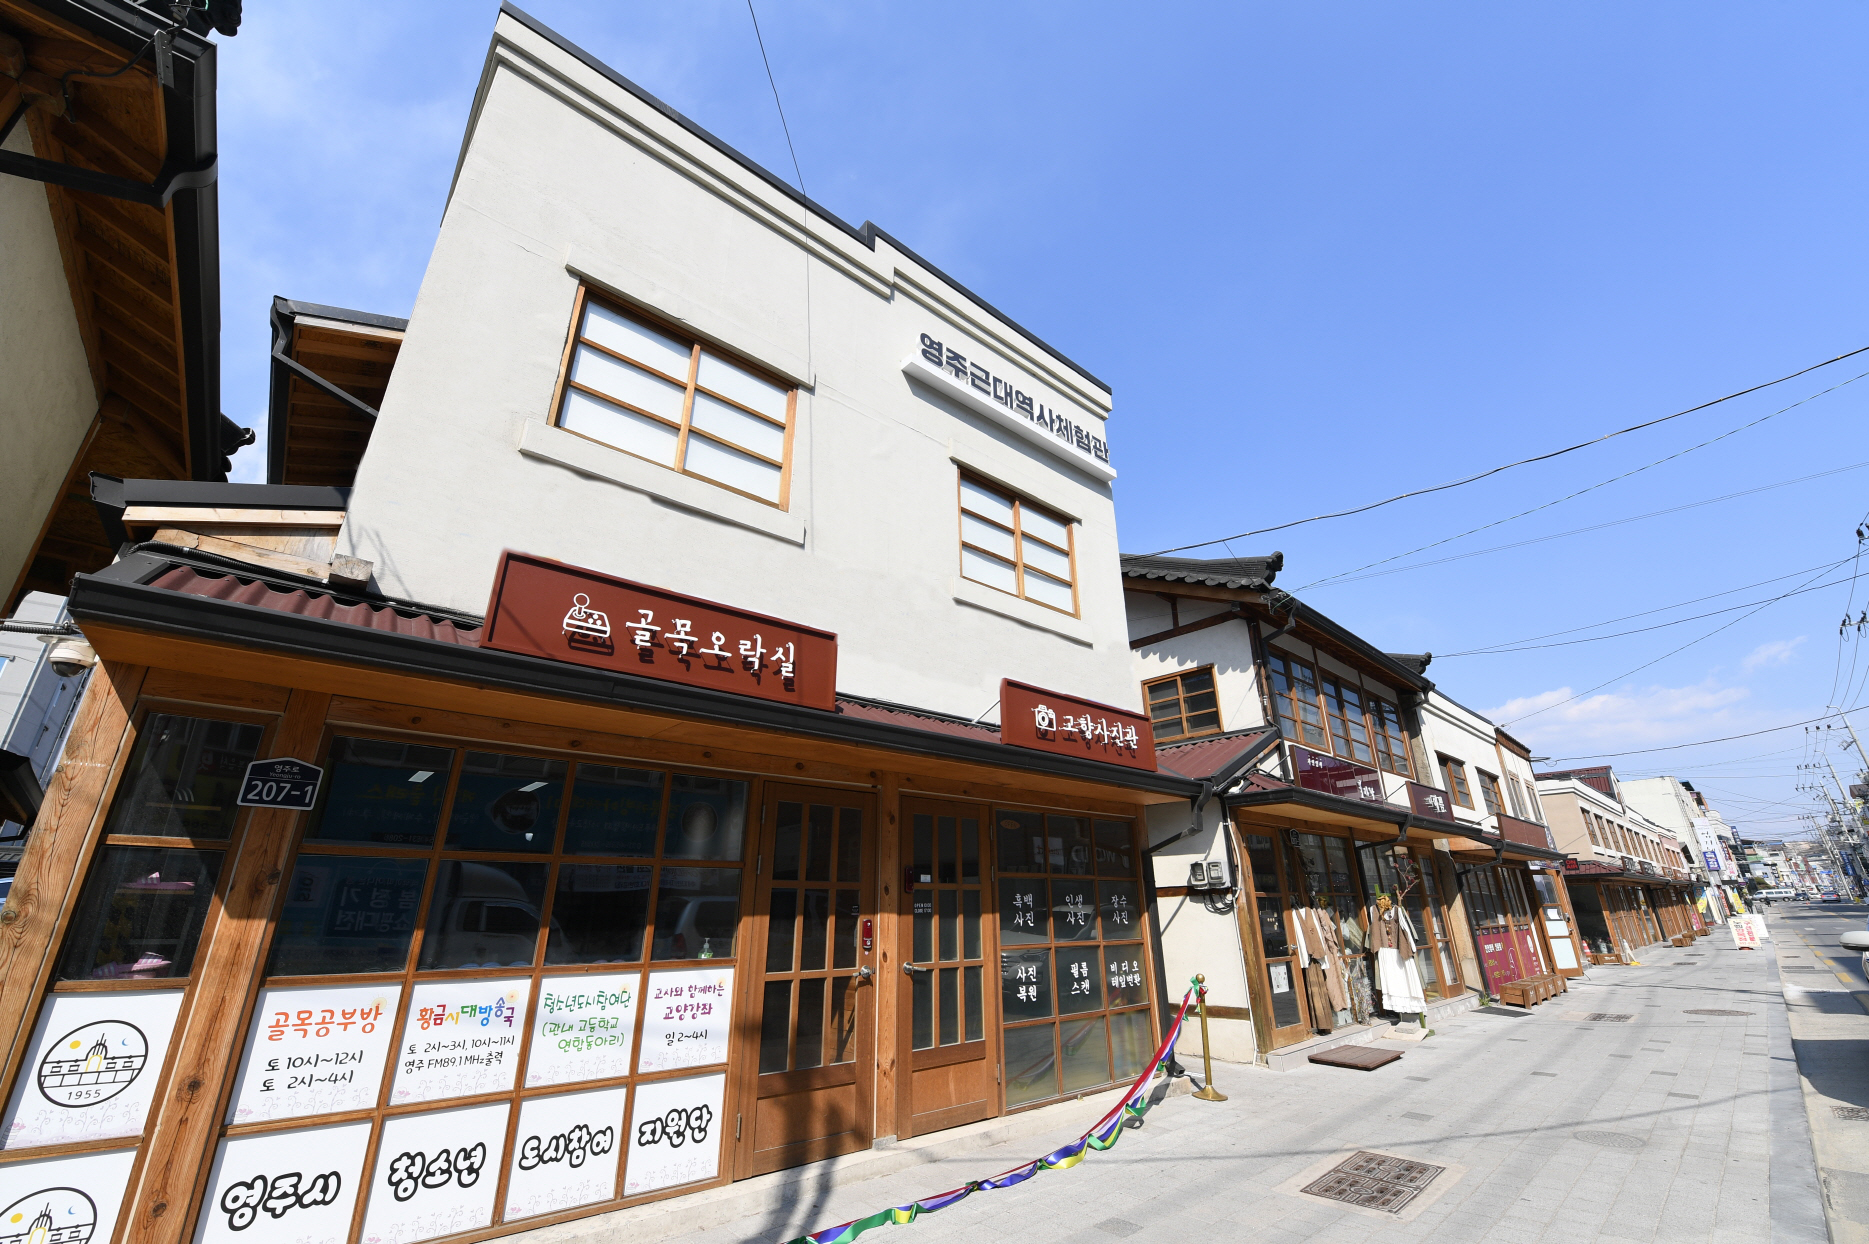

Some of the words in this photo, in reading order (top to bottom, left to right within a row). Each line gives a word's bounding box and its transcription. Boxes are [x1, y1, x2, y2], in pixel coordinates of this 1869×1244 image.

[919, 332, 1110, 463] 영주근대역사체험관
[625, 609, 796, 679] 골목오락실
[1058, 713, 1139, 750] 고향사진관
[269, 771, 302, 780] Yeongju-ro
[274, 764, 300, 773] 영주로
[246, 780, 314, 804] 207-1
[1012, 893, 1033, 908] 흑백
[1065, 893, 1083, 908] 인생
[1110, 894, 1127, 908] 장수
[1013, 911, 1035, 927] 사진
[1066, 911, 1085, 926] 사진
[1112, 910, 1129, 925] 사진
[1016, 965, 1037, 983] 사진
[1070, 962, 1089, 979] 필름
[654, 986, 684, 999] 교사와
[687, 982, 725, 999] 함께하는
[1016, 985, 1037, 1003] 복원
[1070, 979, 1090, 995] 스캔
[543, 990, 632, 1014] 청소년도시참여단
[416, 997, 515, 1031] 황금시대방송국
[663, 1002, 713, 1021] 교양강좌
[267, 1005, 383, 1042] 골목공부방
[541, 1021, 574, 1037] (관내
[578, 1017, 619, 1033] 고등학교
[407, 1043, 417, 1055] 토
[424, 1039, 468, 1053] 2시~3시,
[471, 1034, 515, 1048] 10시~11시
[557, 1032, 625, 1053] 연합동아리)
[665, 1031, 675, 1047] 일
[677, 1029, 708, 1042] 2~4시
[264, 1058, 280, 1072] 토
[286, 1049, 364, 1070] 10시~12시
[404, 1059, 425, 1074] 영주
[259, 1078, 276, 1092] 토
[286, 1069, 354, 1089] 2시~4시
[66, 1088, 102, 1101] 1955
[638, 1103, 713, 1148] 지원단
[387, 1141, 487, 1202] 청소년
[220, 1170, 341, 1232] 영주시
